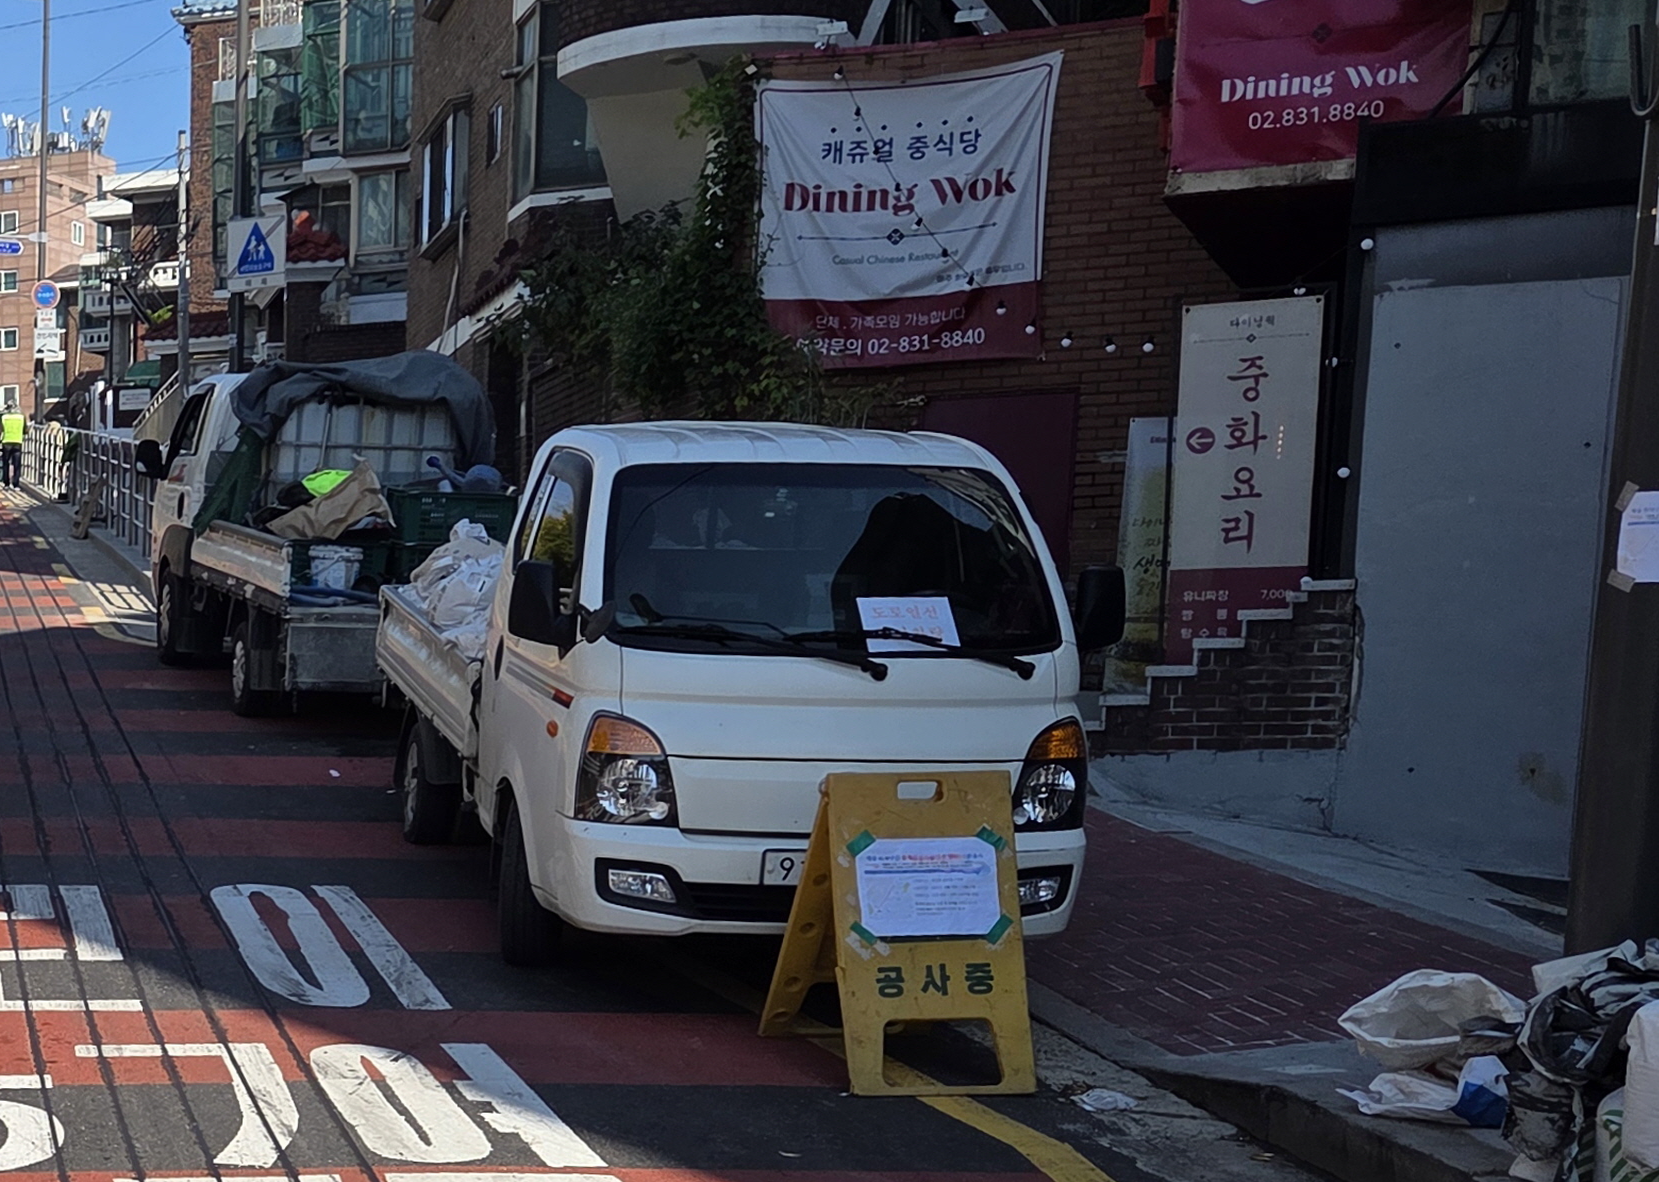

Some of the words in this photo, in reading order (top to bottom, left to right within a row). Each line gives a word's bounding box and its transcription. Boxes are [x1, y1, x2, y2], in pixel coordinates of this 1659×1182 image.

[1220, 70, 1336, 102] Dining
[1344, 59, 1419, 89] Wok
[1247, 100, 1385, 130] 02.831.8840
[821, 137, 894, 164] 캐쥬얼
[906, 128, 982, 160] 중식당
[783, 182, 918, 217] Dining
[929, 167, 1017, 206] Wok
[831, 255, 865, 266] Casual
[867, 254, 905, 265] Chinese
[850, 314, 900, 330] 가족모임
[905, 306, 966, 326] 가능합니다
[868, 327, 986, 355] 02-831-8840
[1220, 355, 1269, 554] 중화요리
